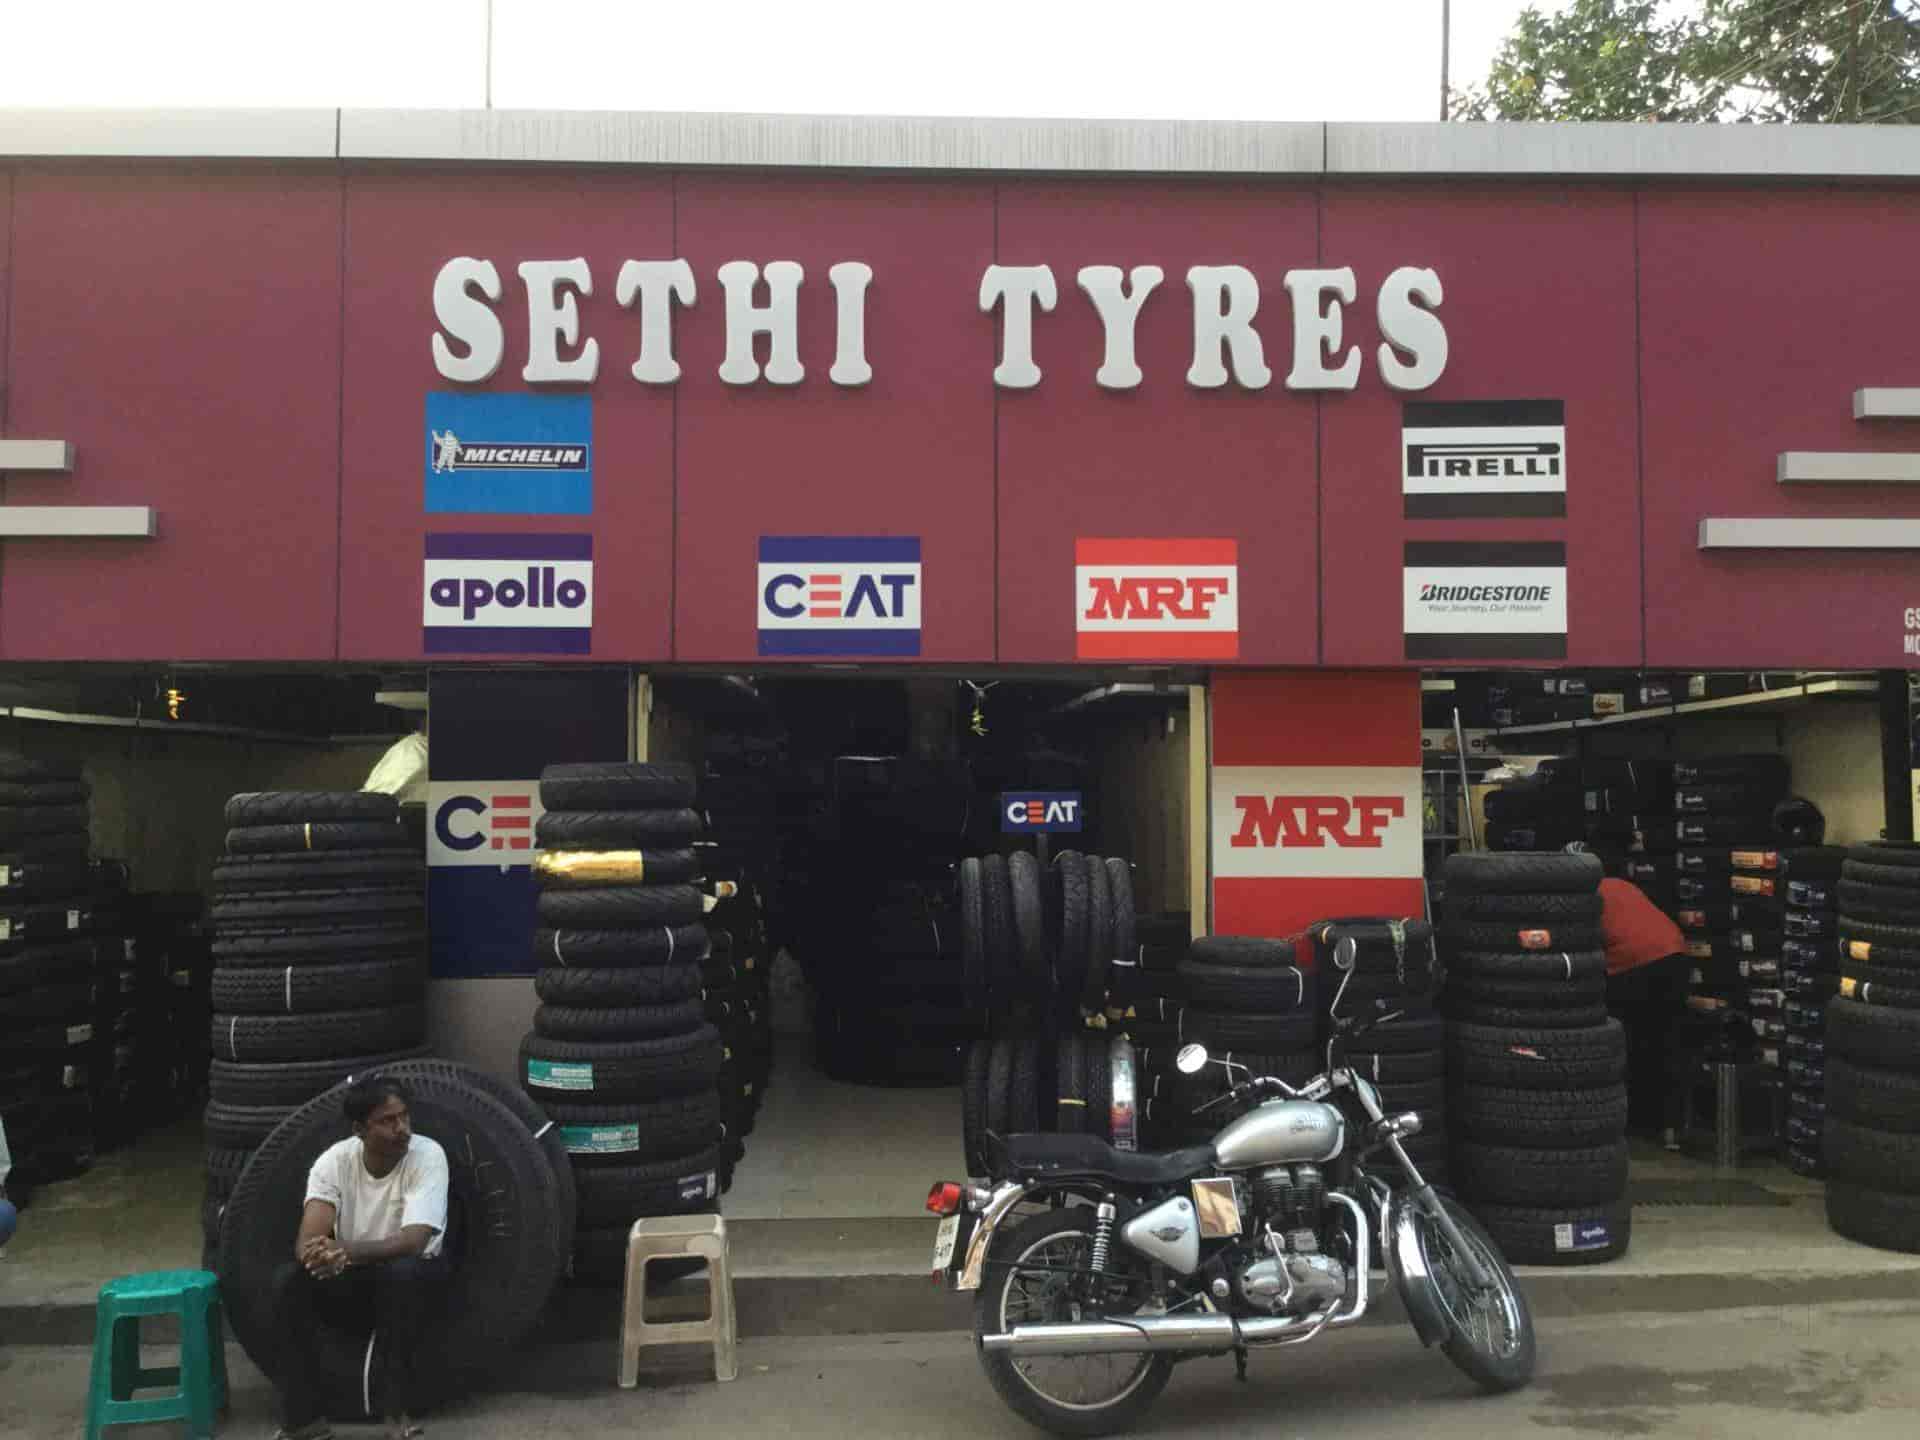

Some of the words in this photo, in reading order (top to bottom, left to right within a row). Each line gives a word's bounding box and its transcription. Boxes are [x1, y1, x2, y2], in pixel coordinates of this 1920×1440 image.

[432, 256, 873, 385] SETHI
[979, 264, 1448, 390] TYRES
[463, 449, 583, 463] MICHELIN
[1407, 442, 1561, 477] PIRELLI
[430, 567, 587, 620] apollo
[764, 574, 916, 619] CEAT
[1085, 577, 1228, 620] MRF
[1419, 584, 1551, 601] BRIDGESTONE
[435, 795, 531, 851] CE
[1006, 800, 1078, 824] CEAT
[1230, 796, 1404, 848] MRF
